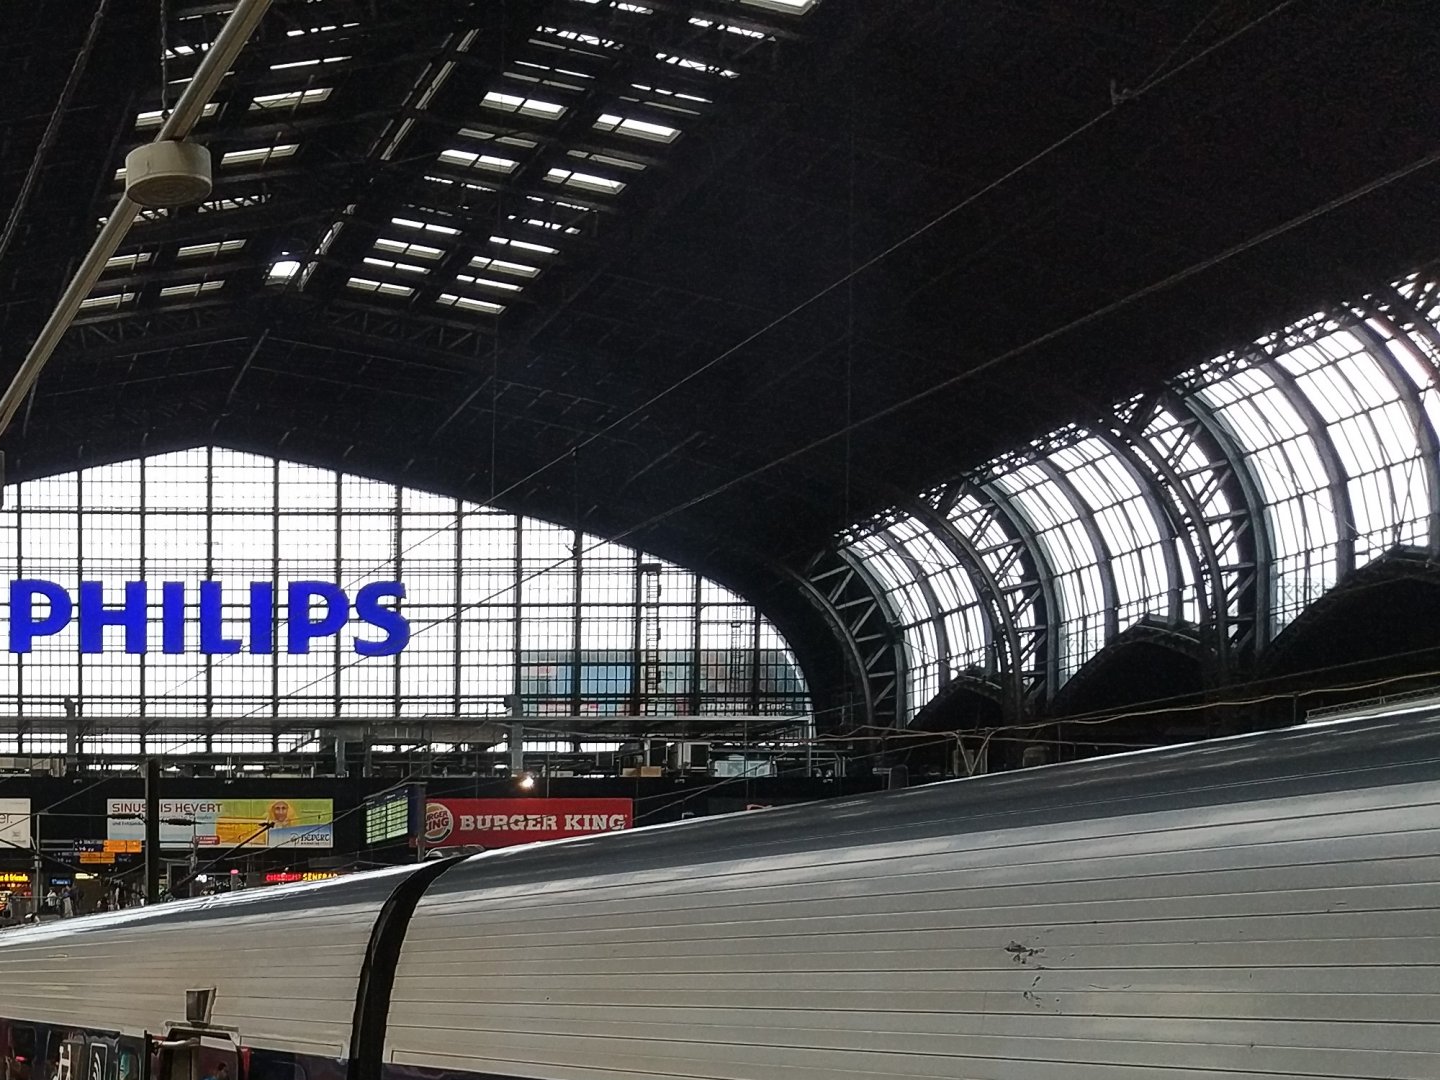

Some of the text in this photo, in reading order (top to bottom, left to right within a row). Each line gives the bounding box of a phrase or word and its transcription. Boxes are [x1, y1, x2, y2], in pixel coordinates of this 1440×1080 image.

[9, 578, 411, 657] PHILIPS
[175, 803, 223, 813] HEVERT
[460, 813, 625, 831] BURGER KING
